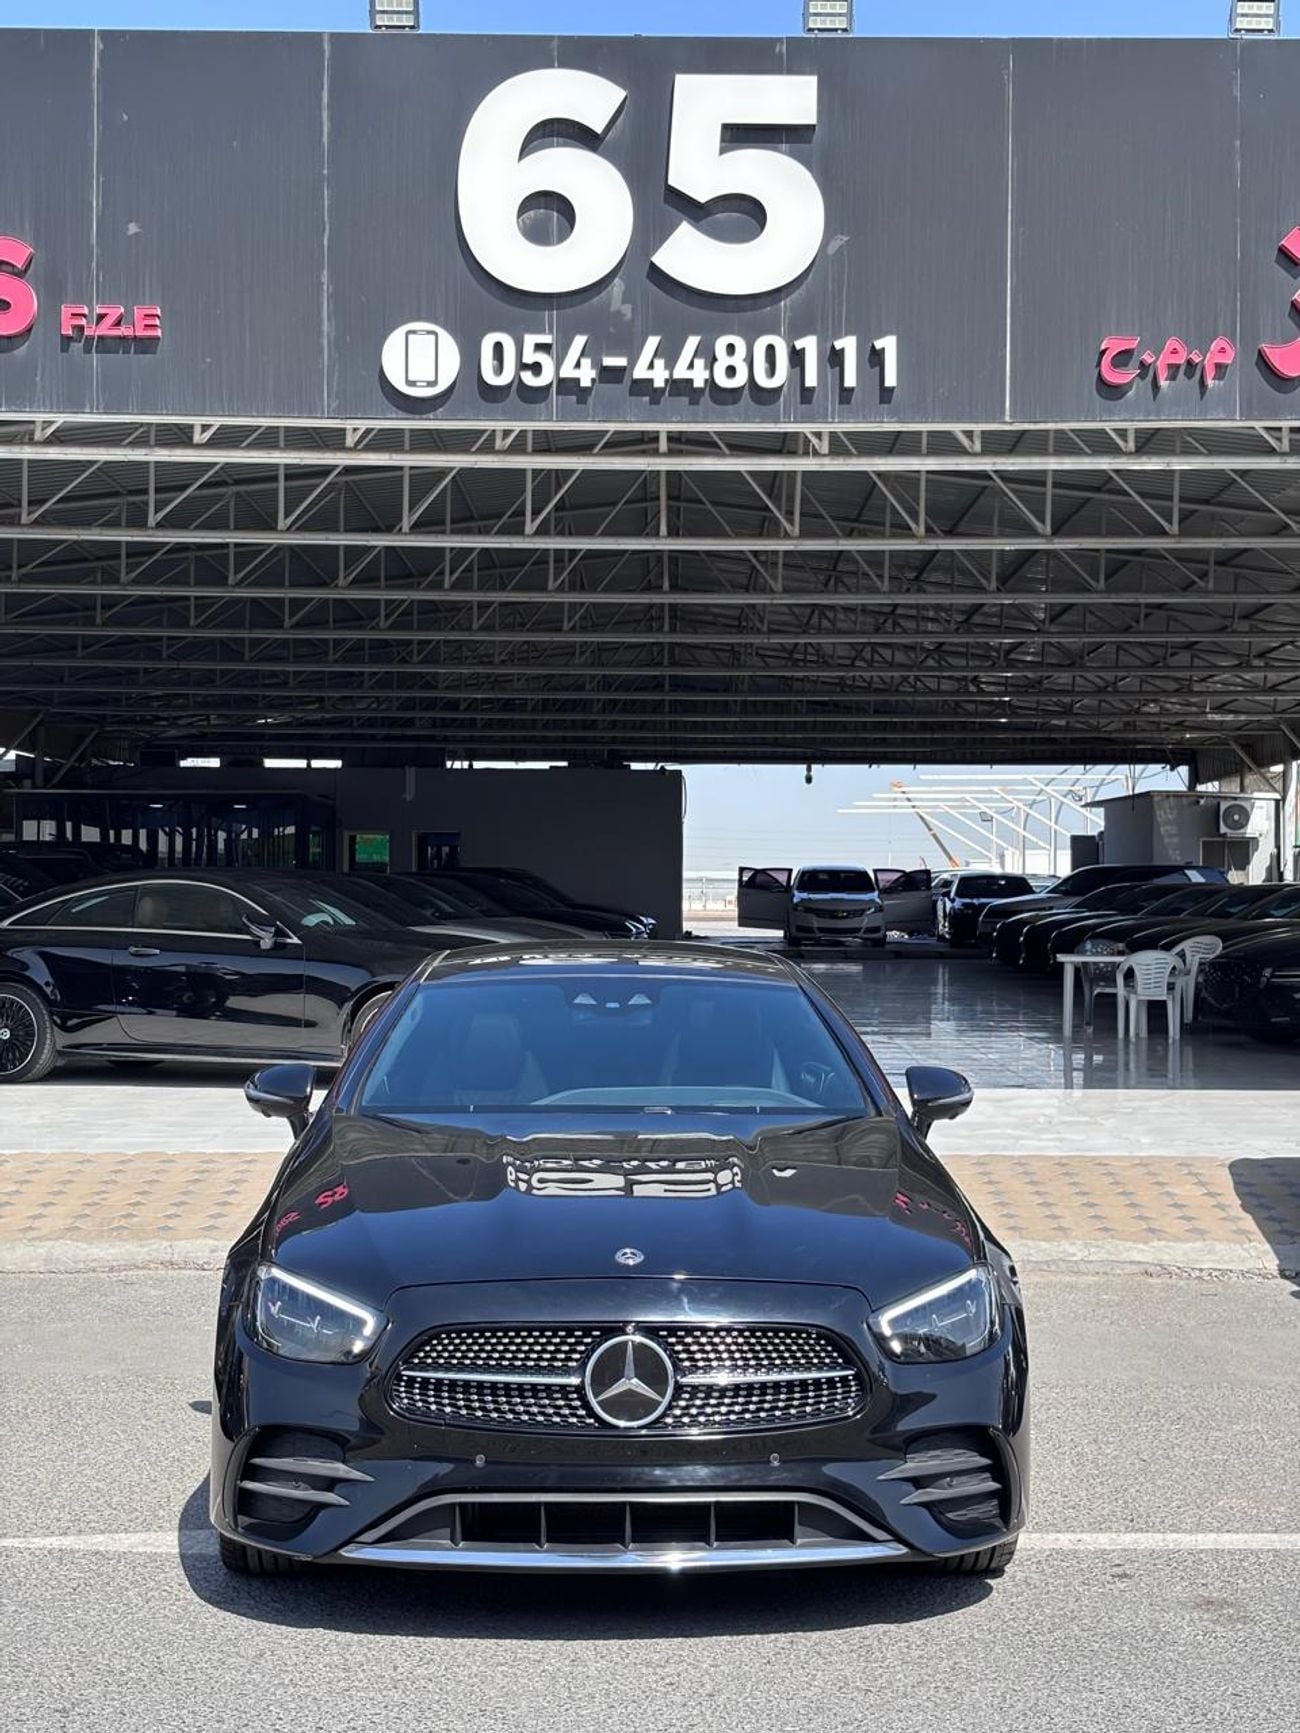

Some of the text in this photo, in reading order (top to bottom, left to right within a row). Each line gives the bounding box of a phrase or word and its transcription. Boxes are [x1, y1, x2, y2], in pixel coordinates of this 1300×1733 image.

[456, 68, 825, 295] 65
[60, 304, 162, 339] F.Z.E
[480, 332, 899, 388] 054-4480111
